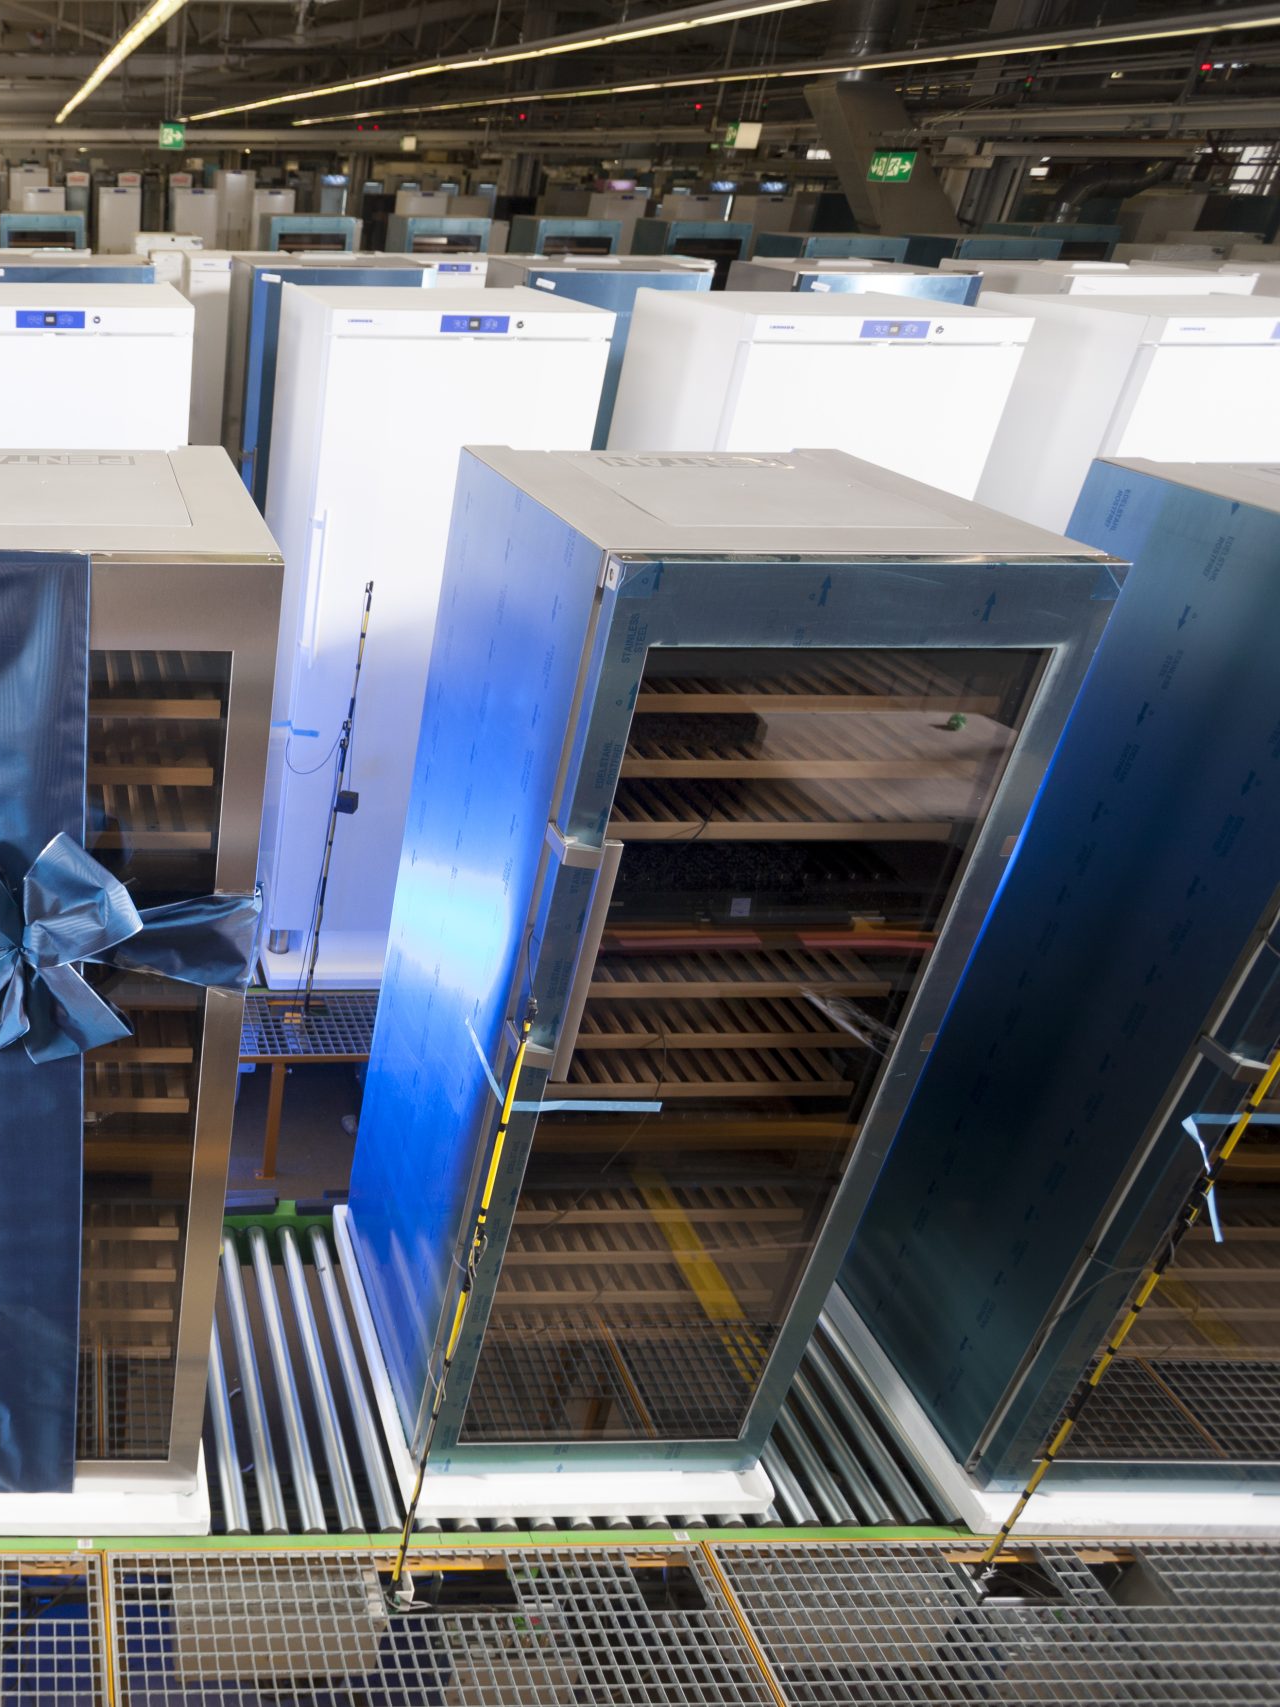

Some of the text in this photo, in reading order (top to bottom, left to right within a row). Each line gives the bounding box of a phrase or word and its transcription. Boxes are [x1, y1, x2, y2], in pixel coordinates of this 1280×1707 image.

[621, 612, 640, 664] STAINLESS
[633, 623, 648, 653] STEEL
[595, 740, 613, 789] EDELSTAHL
